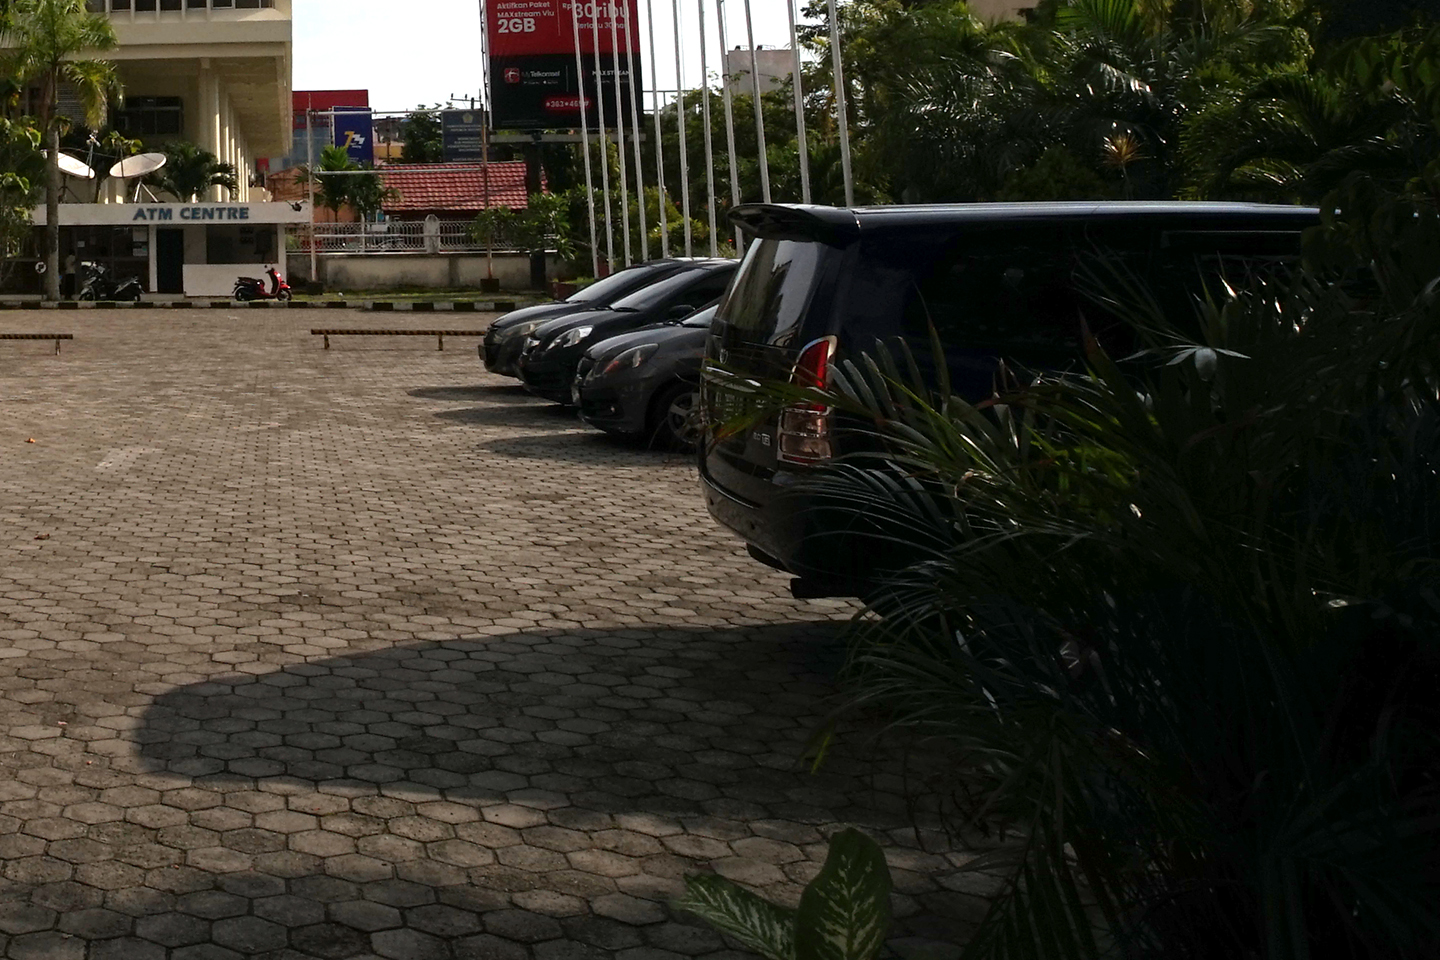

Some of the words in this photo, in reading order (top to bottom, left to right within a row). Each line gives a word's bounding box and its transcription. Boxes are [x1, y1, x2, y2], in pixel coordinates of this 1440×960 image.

[497, 1, 528, 10] Aktifkan
[529, 1, 551, 9] Paket
[542, 9, 555, 17] Viu
[497, 18, 536, 33] 2GB
[132, 207, 173, 221] ATM
[179, 206, 250, 220] CENTRE
